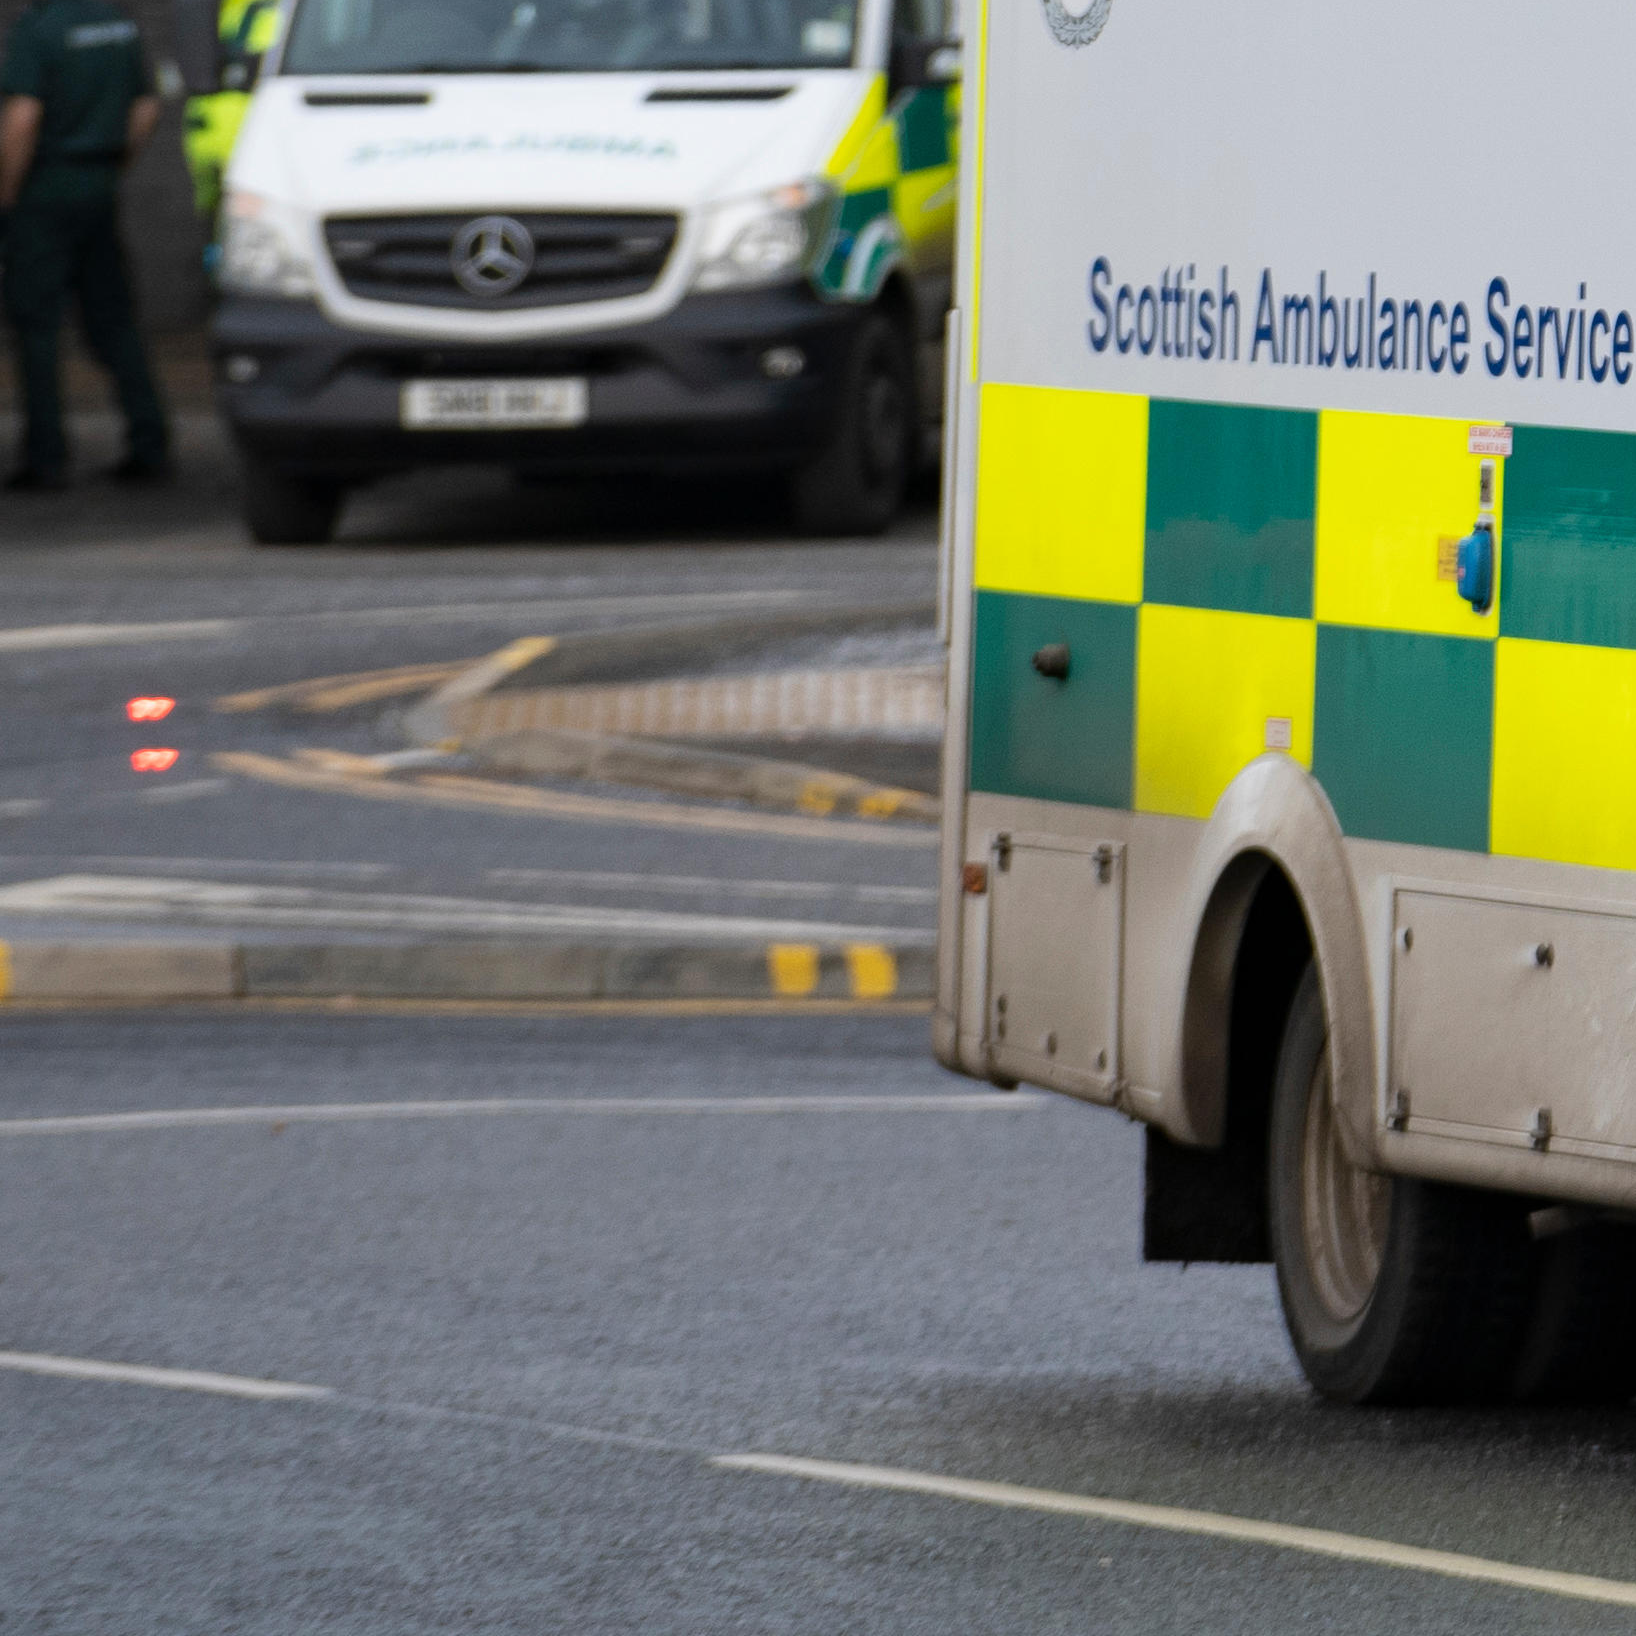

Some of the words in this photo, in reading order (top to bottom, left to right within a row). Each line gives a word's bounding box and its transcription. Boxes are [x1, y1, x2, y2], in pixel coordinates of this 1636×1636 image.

[1088, 255, 1240, 361] Scottish
[1251, 267, 1471, 373] Ambulance
[1484, 275, 1635, 385] Service
